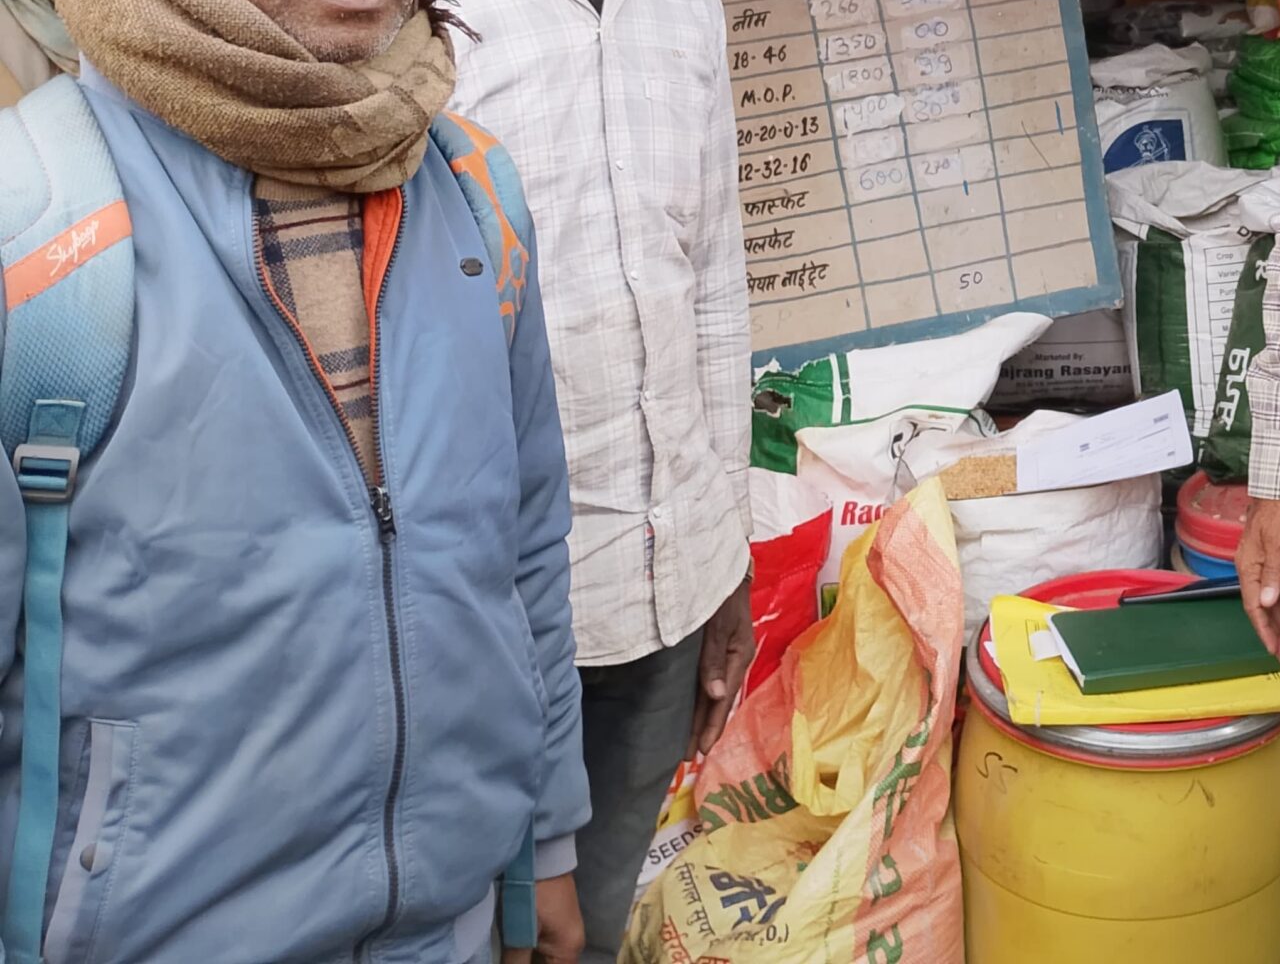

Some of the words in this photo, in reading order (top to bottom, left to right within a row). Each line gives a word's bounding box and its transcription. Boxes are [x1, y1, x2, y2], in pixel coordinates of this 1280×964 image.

[732, 8, 771, 32] नीम
[959, 270, 984, 289] 50
[1000, 364, 1055, 380] ajrang
